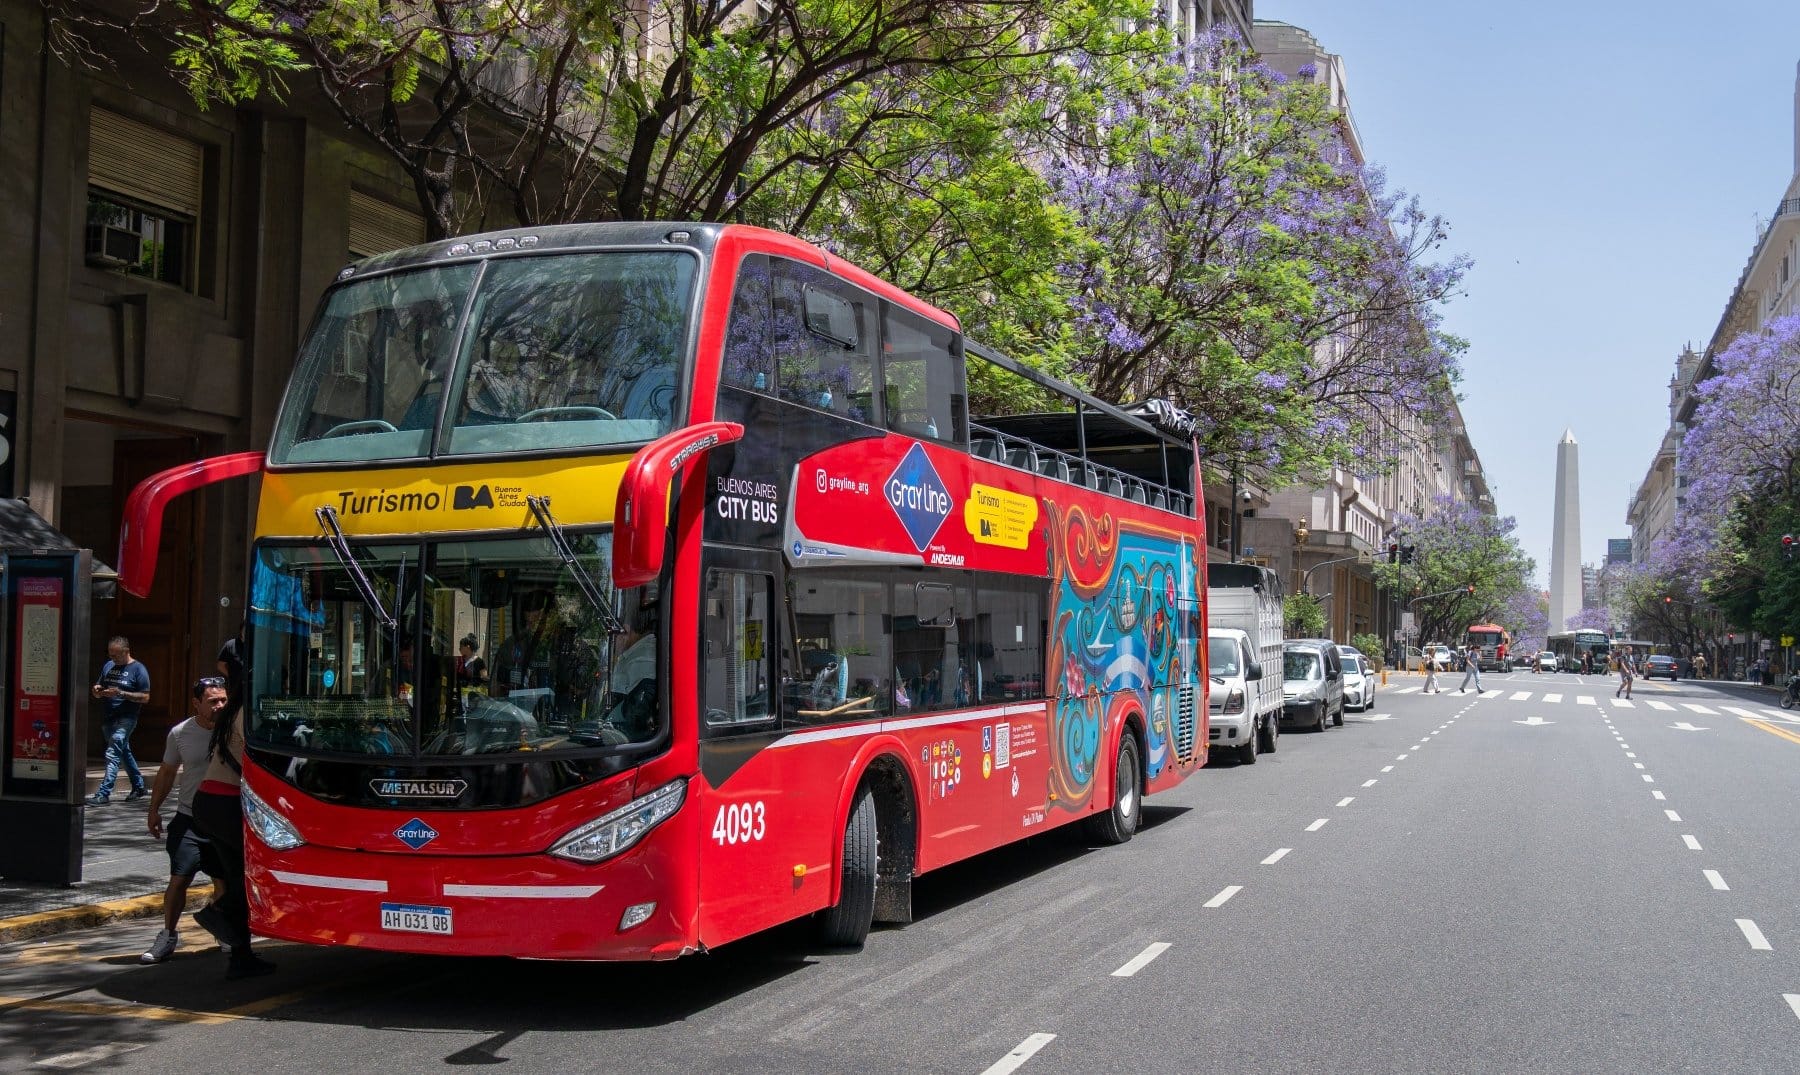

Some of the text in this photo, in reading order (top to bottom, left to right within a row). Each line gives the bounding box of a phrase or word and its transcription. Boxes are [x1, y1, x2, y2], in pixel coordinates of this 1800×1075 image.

[717, 476, 777, 500] BUENOS AIRES
[829, 476, 869, 495] grayline_arg
[338, 484, 495, 516] Turismo BA
[499, 499, 527, 507] Ciudad
[976, 490, 1000, 508] Turismo
[717, 495, 778, 524] CITY BUS
[931, 552, 965, 567] ANDESMAR
[380, 782, 455, 795] METALSUR
[712, 800, 766, 846] 4093
[384, 911, 449, 931] AH 031 QB
